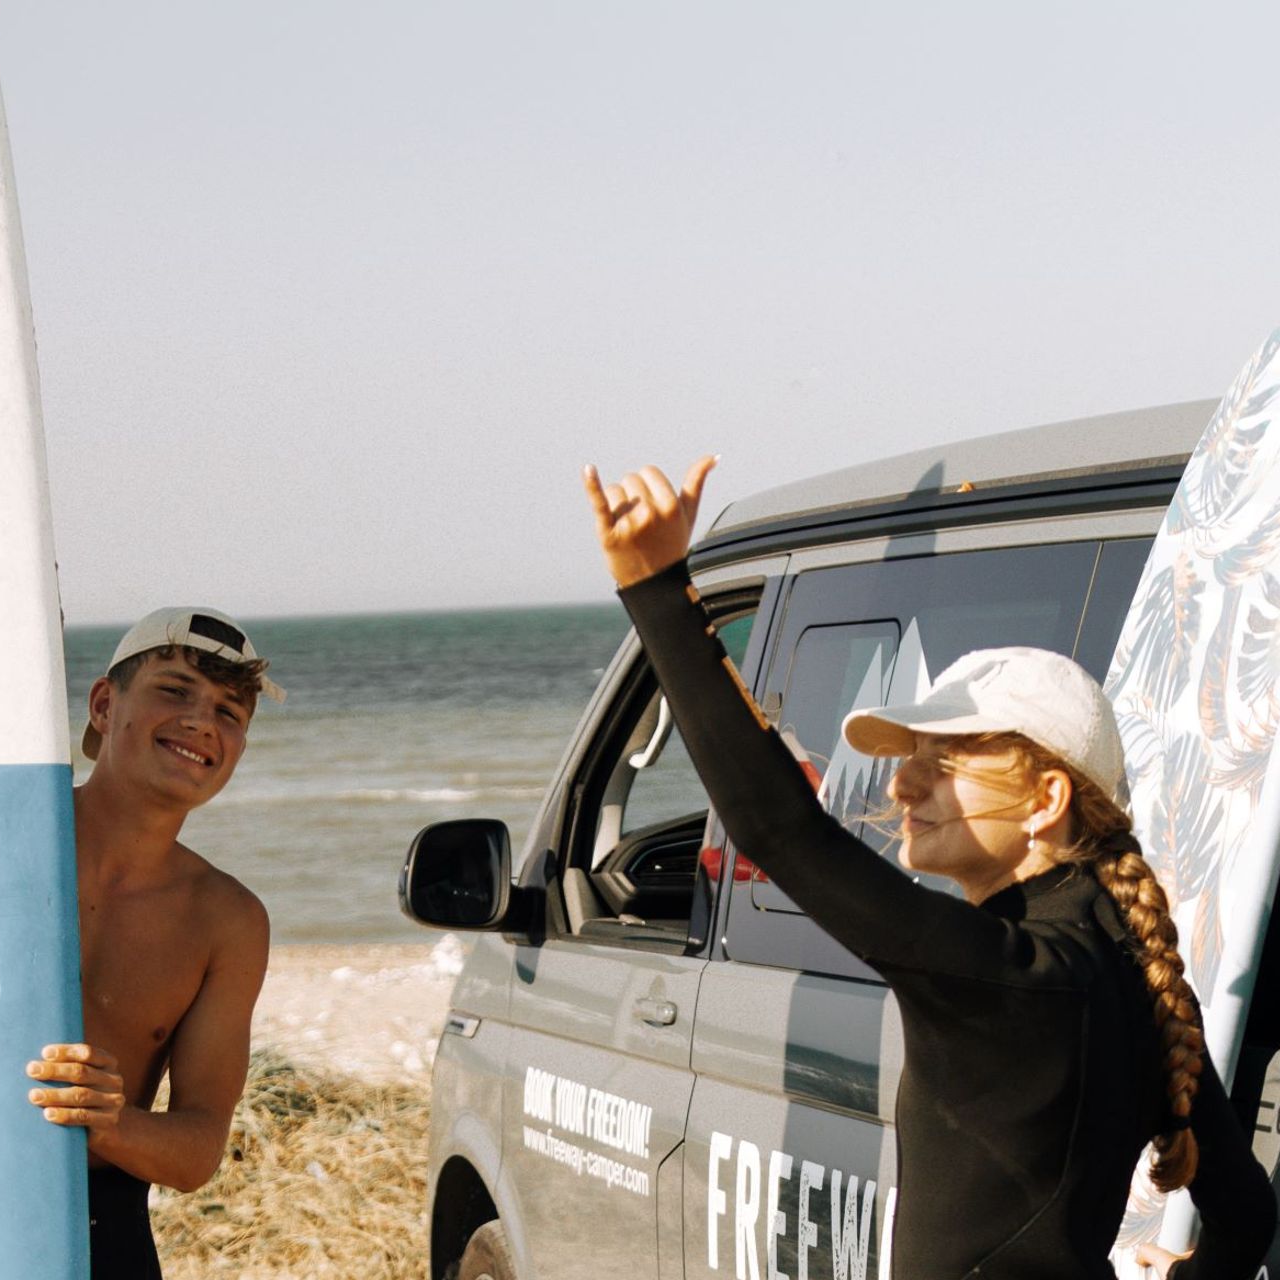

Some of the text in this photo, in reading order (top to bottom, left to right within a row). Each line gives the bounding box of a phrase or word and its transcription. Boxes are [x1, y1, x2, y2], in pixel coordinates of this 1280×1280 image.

[523, 1066, 652, 1159] BOOK YOUR FREEDOM!
[523, 1125, 650, 1196] www.freeway-camper.com
